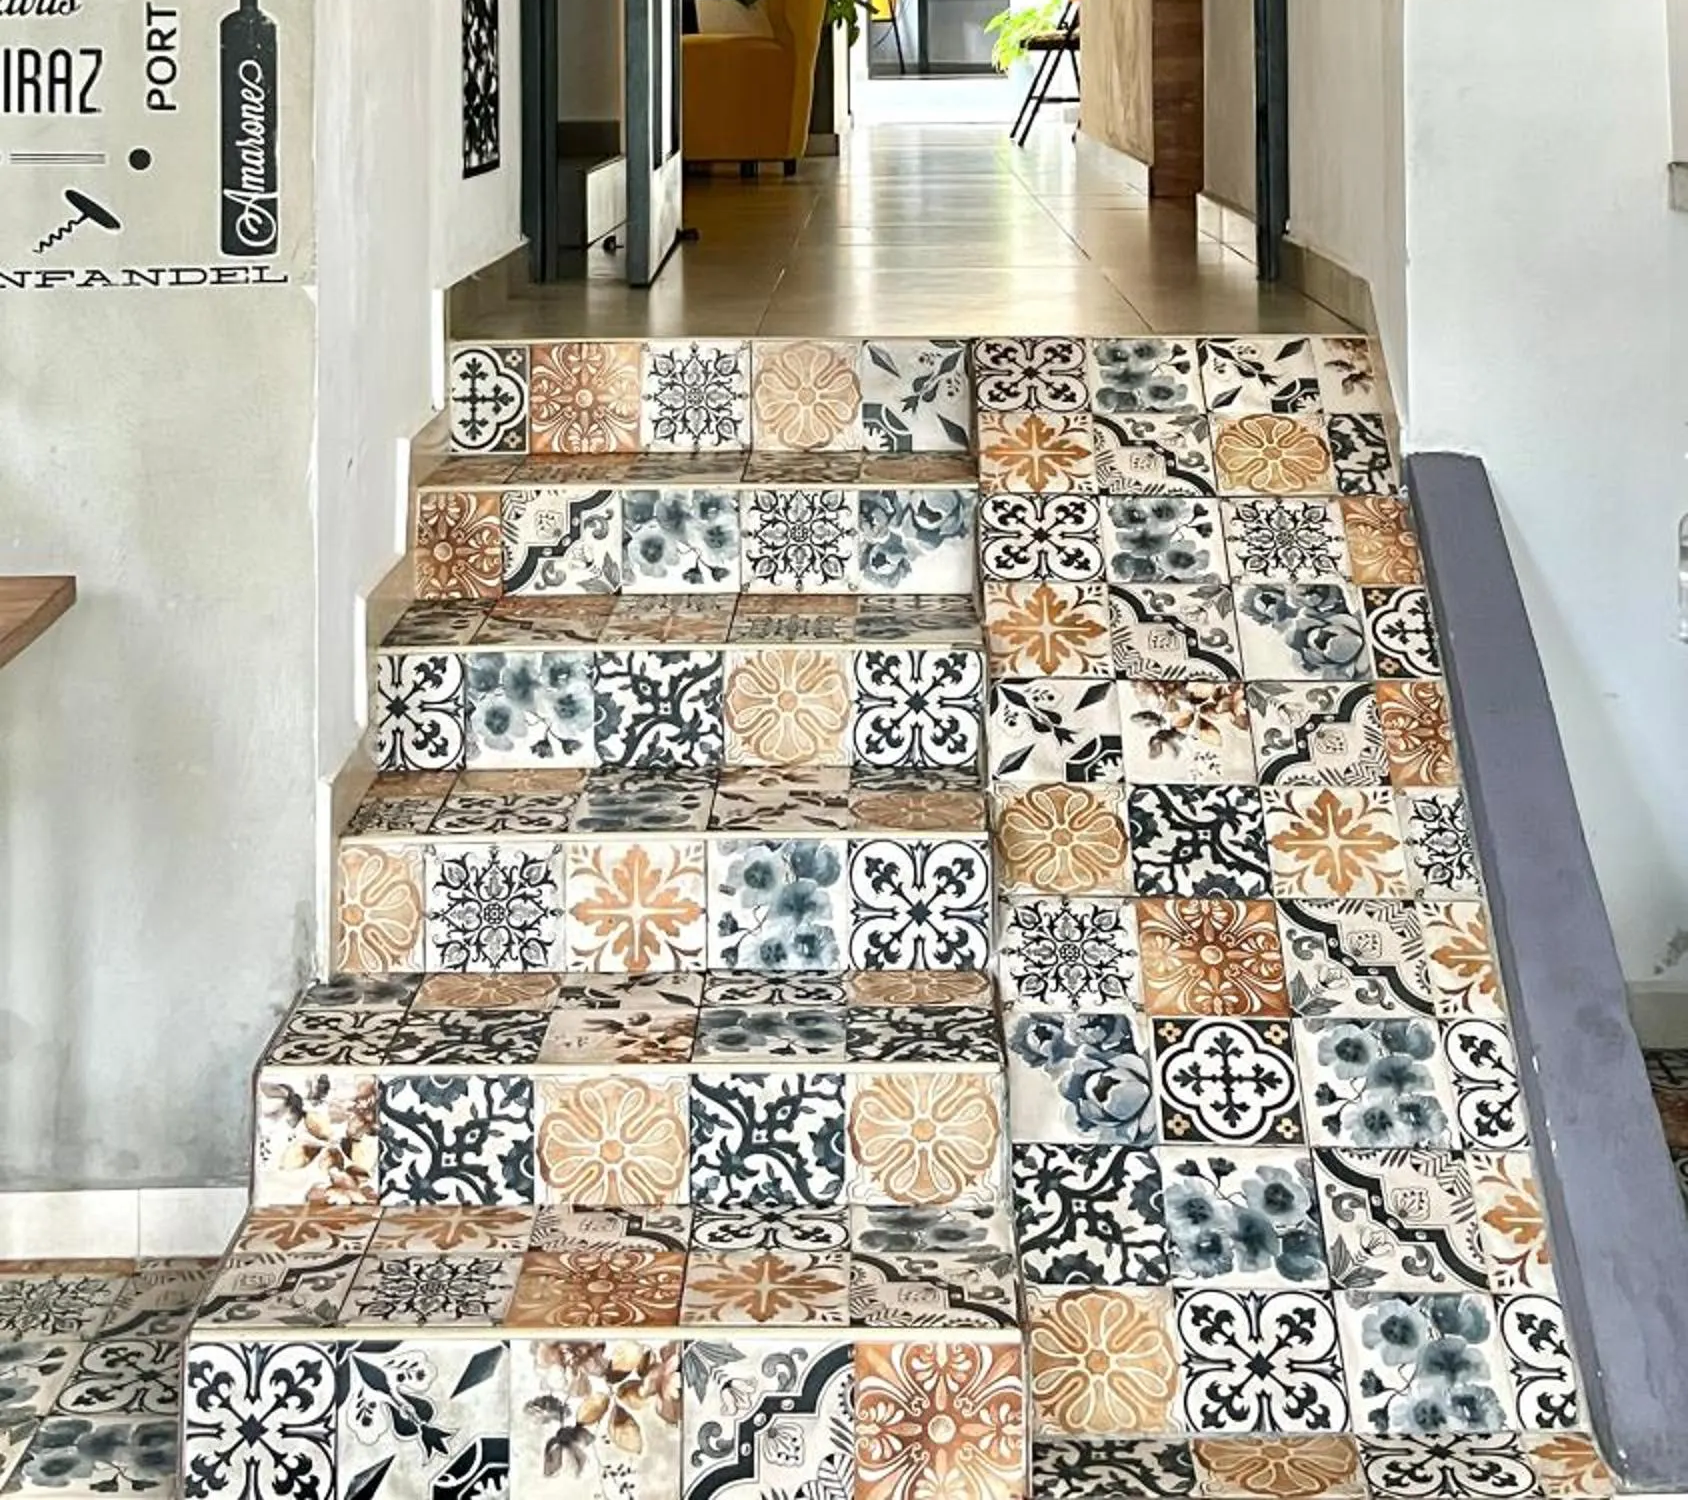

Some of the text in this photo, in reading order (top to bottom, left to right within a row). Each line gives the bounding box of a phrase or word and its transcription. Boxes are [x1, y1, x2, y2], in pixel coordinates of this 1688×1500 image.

[4, 48, 103, 113] IRAZ
[146, 2, 177, 110] PORT
[223, 59, 278, 247] Amarone
